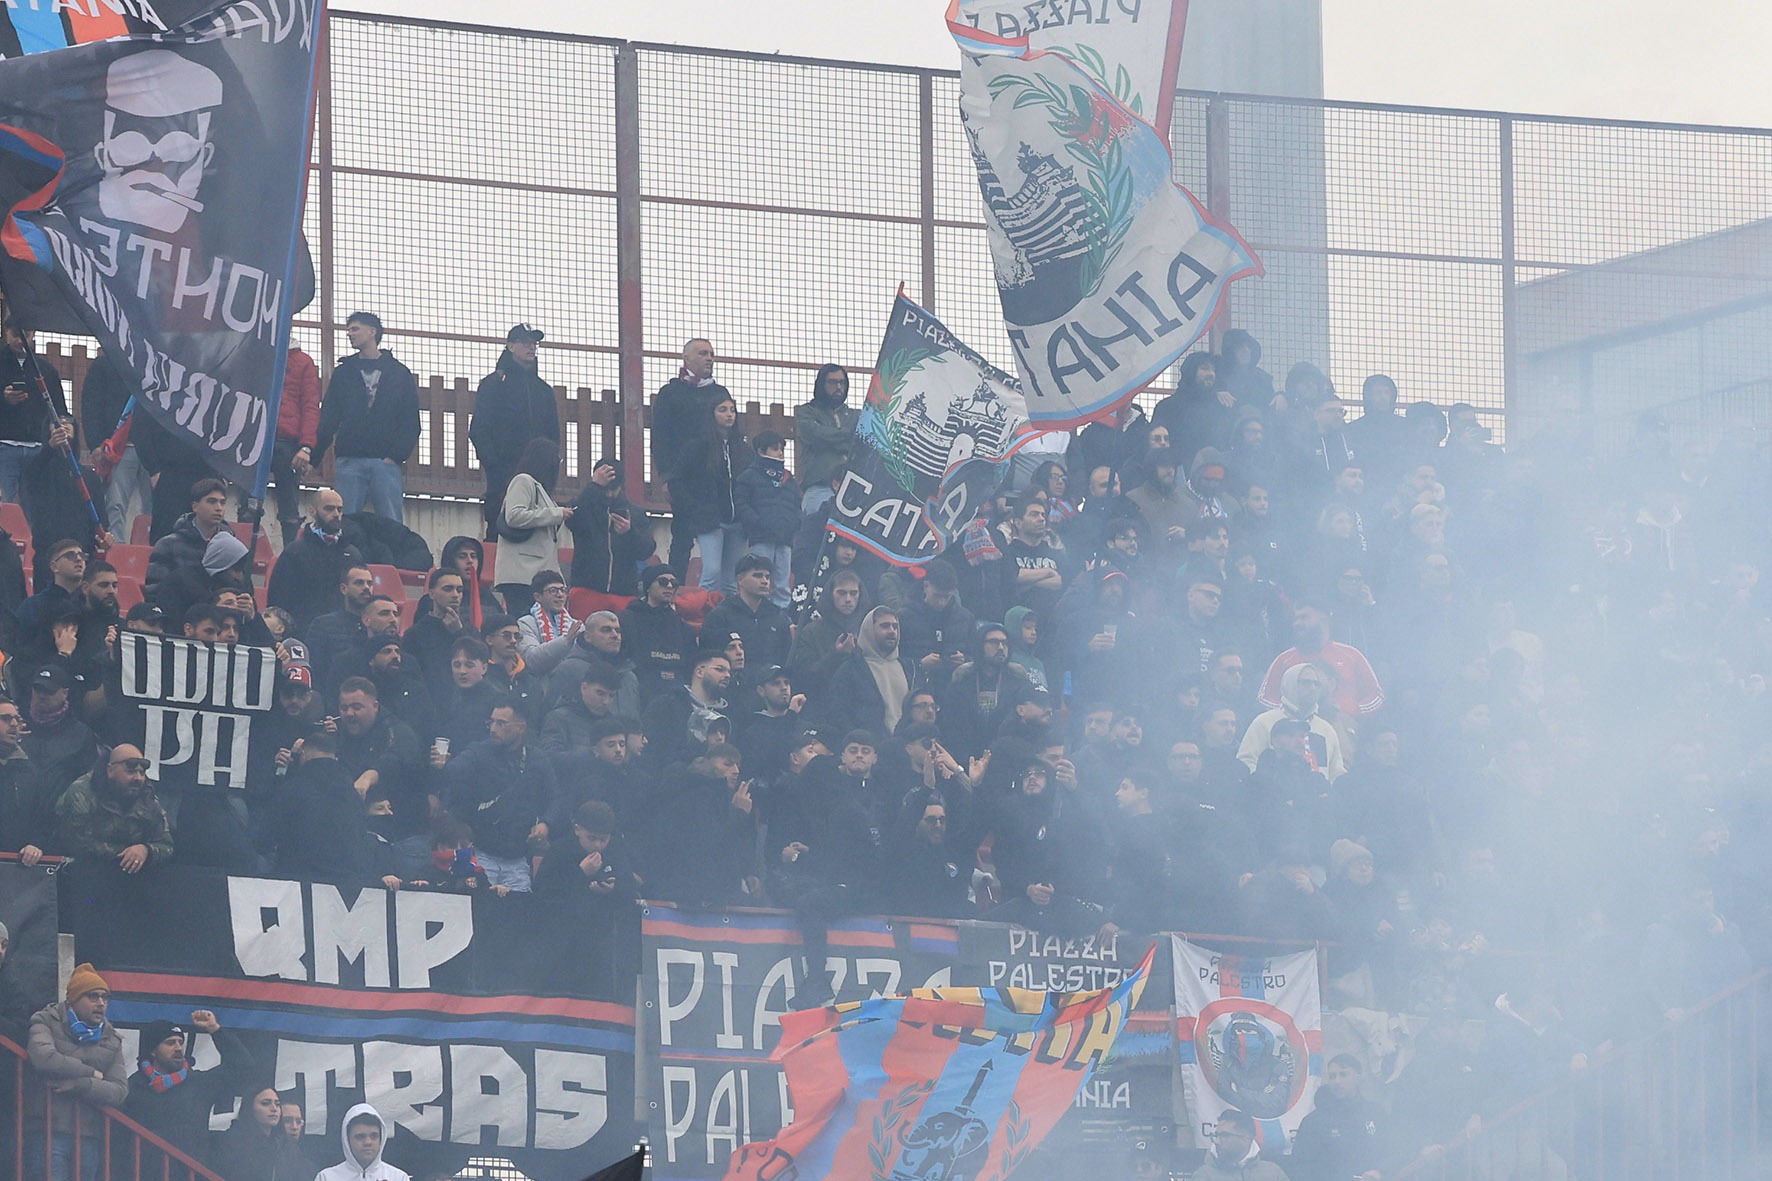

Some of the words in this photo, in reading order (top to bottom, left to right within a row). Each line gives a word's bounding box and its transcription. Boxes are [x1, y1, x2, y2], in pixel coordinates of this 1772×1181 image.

[1007, 251, 1218, 397] TANIA
[120, 630, 277, 711] ODIO
[139, 704, 252, 789] PA
